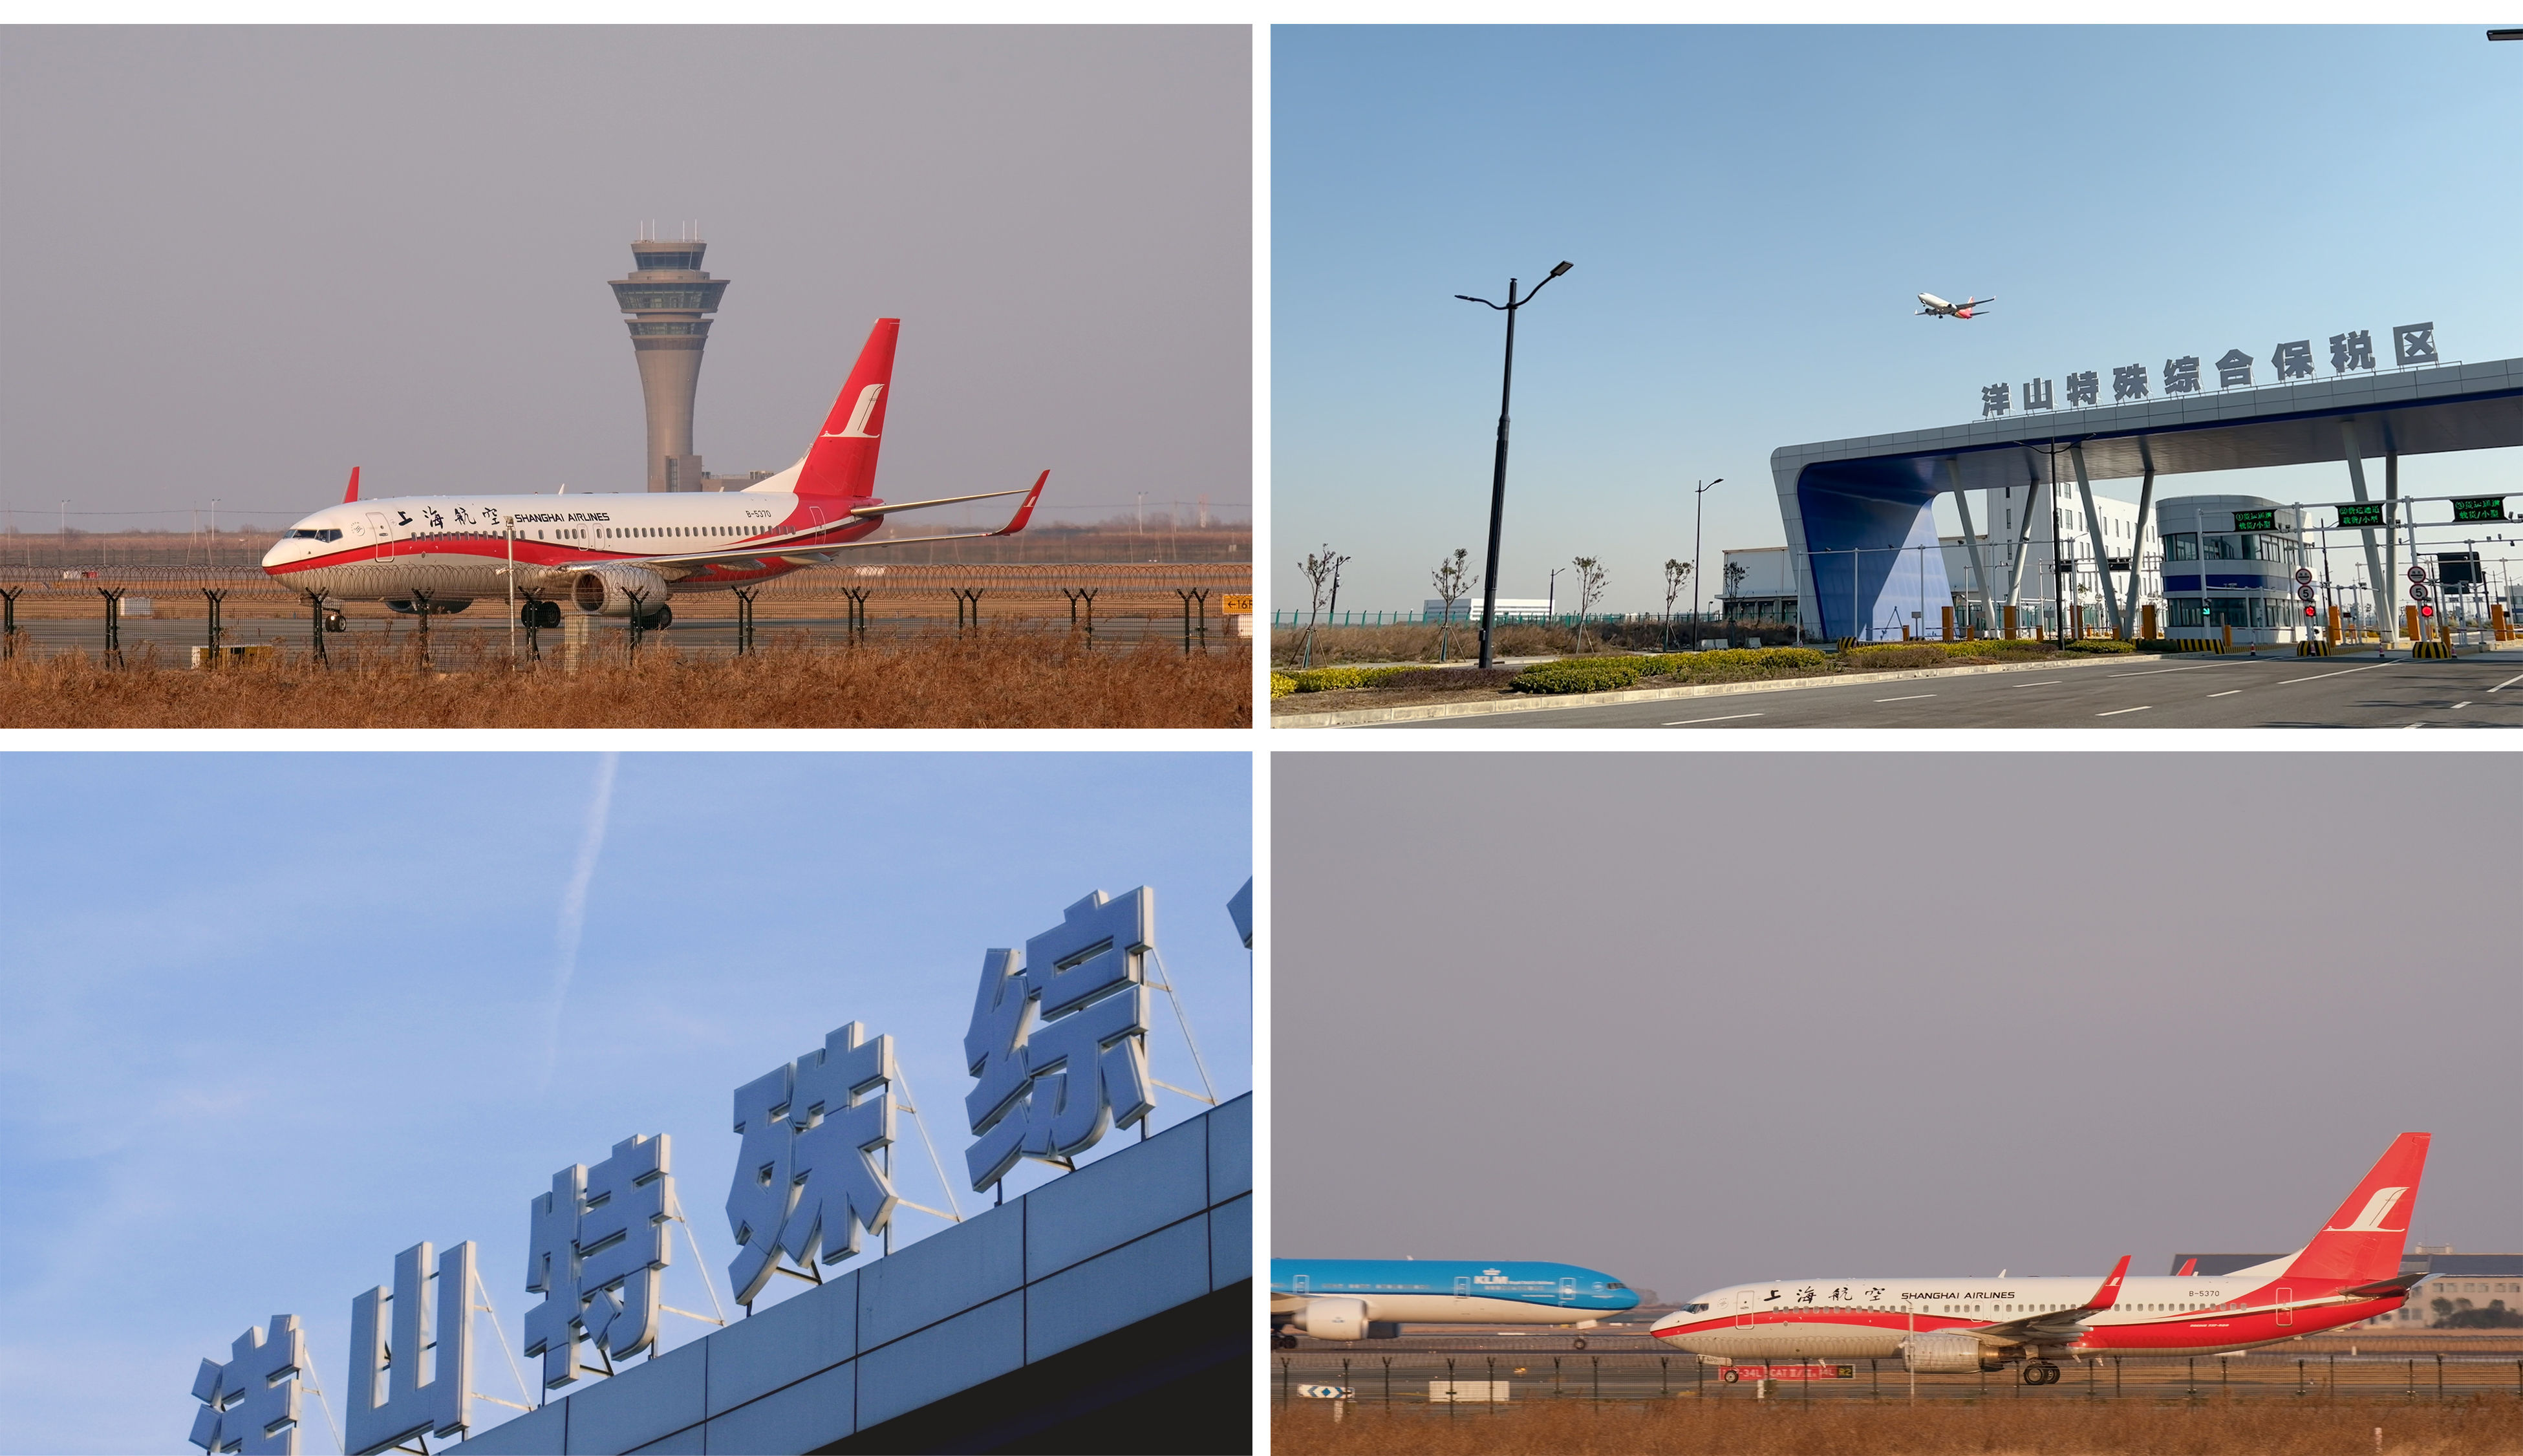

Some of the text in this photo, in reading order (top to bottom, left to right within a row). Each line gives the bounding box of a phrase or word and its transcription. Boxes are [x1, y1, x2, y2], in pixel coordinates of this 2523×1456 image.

[1981, 321, 2439, 417] 洋山特殊综合保税区
[398, 506, 500, 529] 上海航空
[514, 512, 610, 523] SHANGHAI AIRLINES
[2303, 589, 2309, 598] 5
[2415, 588, 2423, 597] 5
[188, 882, 1252, 1456] 洋山特殊综
[1474, 1276, 1508, 1285] KLM
[1763, 1286, 1886, 1304] 上海航空
[1901, 1292, 1960, 1300] SHANGHAI
